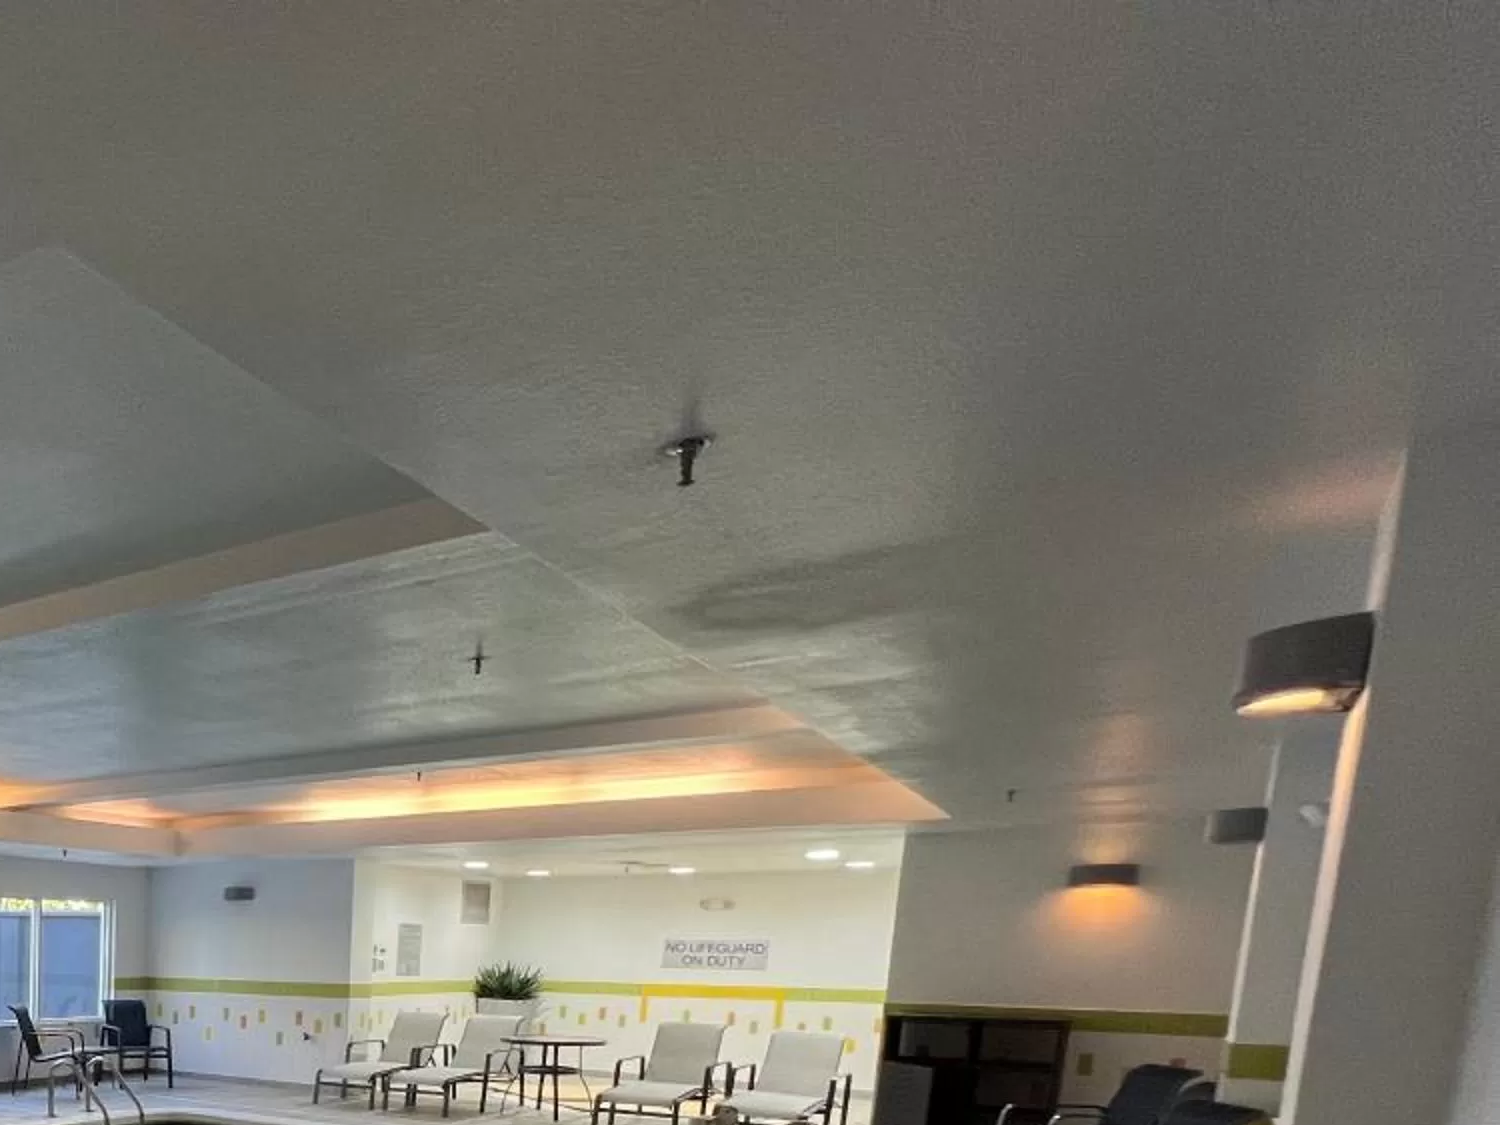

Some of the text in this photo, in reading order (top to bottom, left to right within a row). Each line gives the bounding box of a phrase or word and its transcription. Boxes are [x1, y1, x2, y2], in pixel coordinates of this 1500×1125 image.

[665, 943, 765, 954] NO LIFEGUARD
[680, 954, 745, 967] ON DUTY
